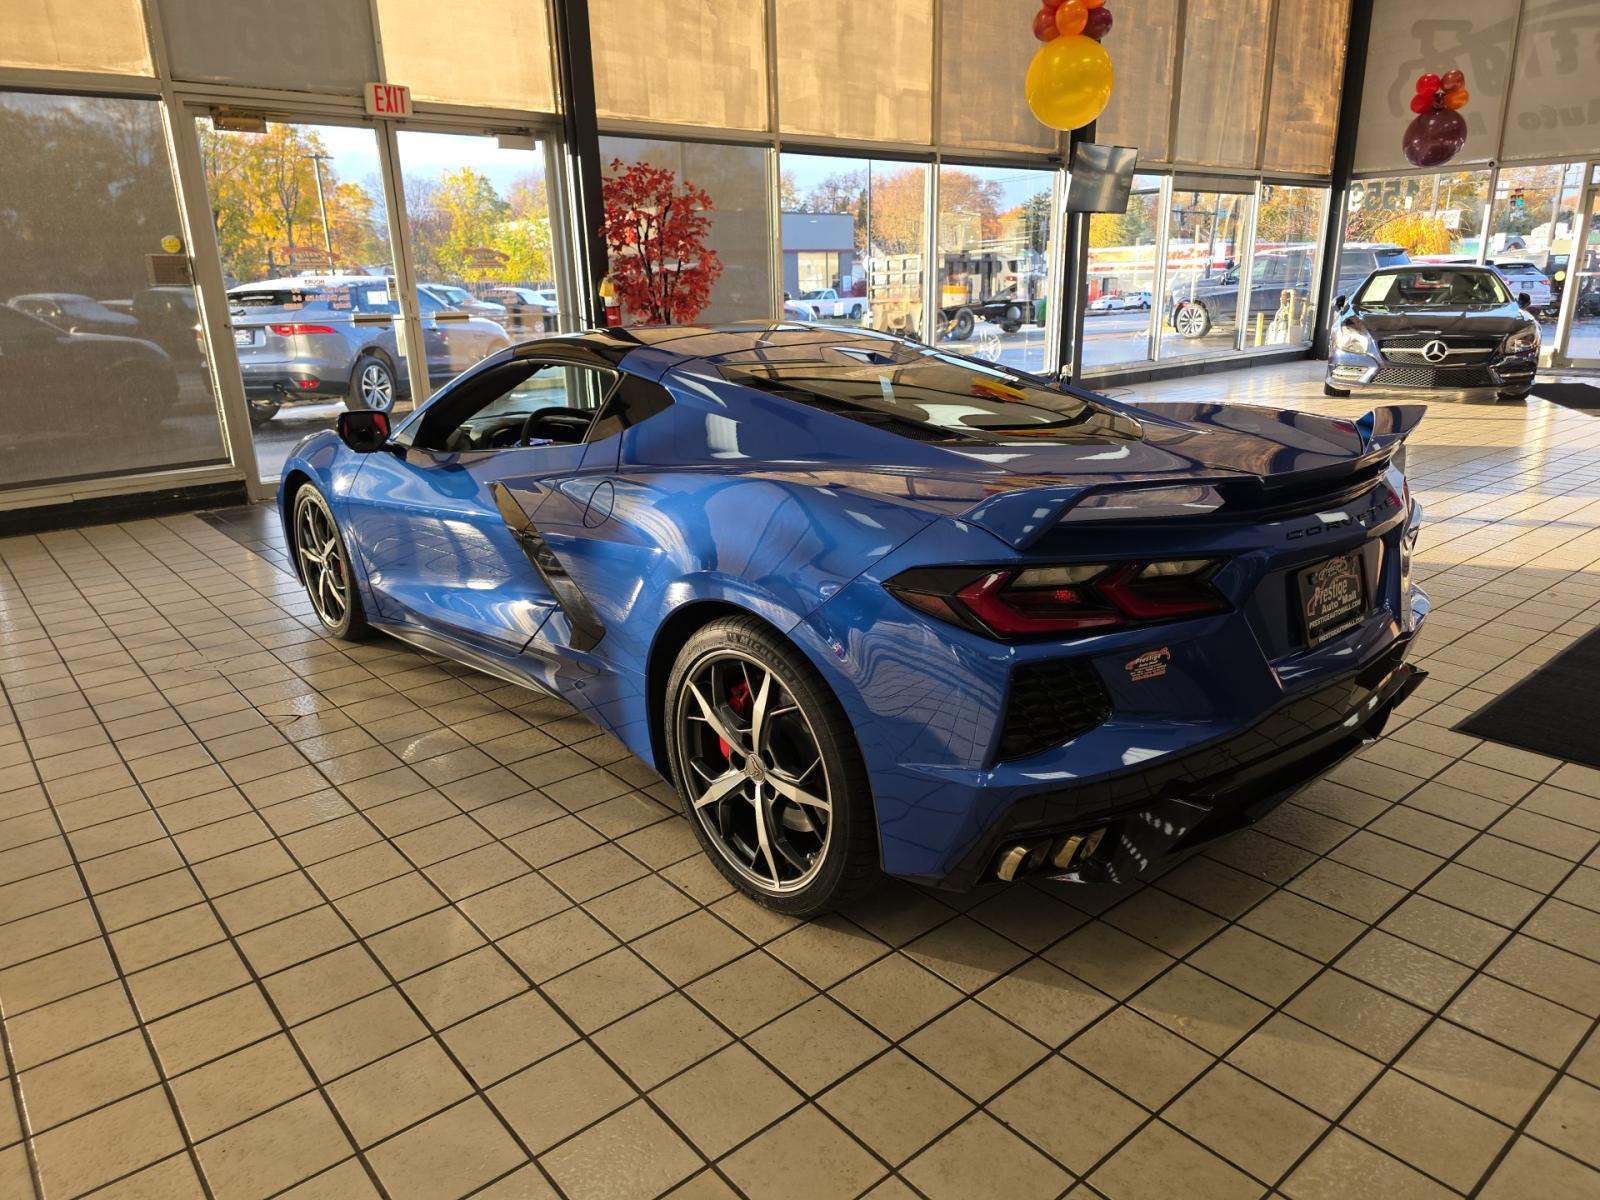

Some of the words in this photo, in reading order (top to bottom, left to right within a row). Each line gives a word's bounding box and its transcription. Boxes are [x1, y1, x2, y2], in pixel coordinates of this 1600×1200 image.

[374, 85, 405, 113] EXIT
[1313, 579, 1348, 606] Prestige
[1321, 600, 1339, 615] Auto
[1342, 590, 1357, 604] Mall
